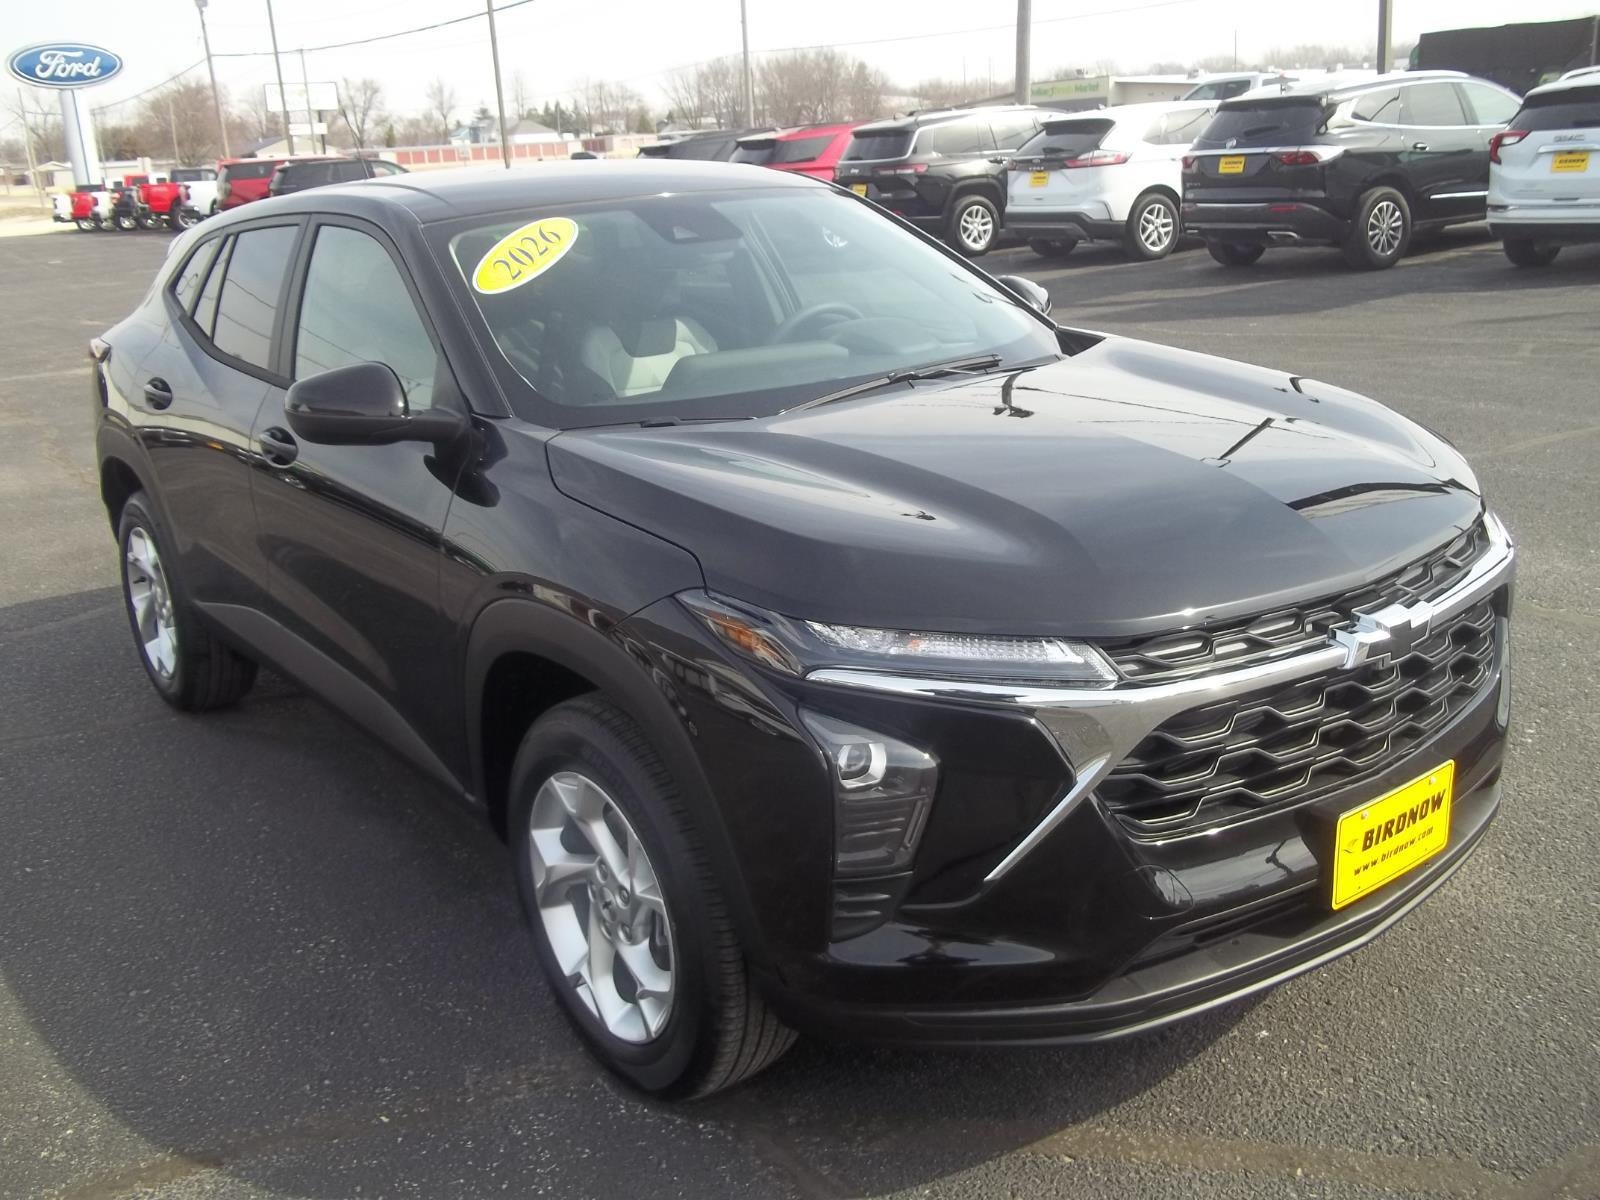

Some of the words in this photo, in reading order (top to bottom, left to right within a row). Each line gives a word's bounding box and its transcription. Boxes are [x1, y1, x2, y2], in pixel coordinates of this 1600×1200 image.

[35, 50, 102, 78] Ford
[493, 225, 562, 280] 2026
[1361, 789, 1446, 852] BIRDNOW
[1354, 826, 1434, 876] www.birdnow.com
